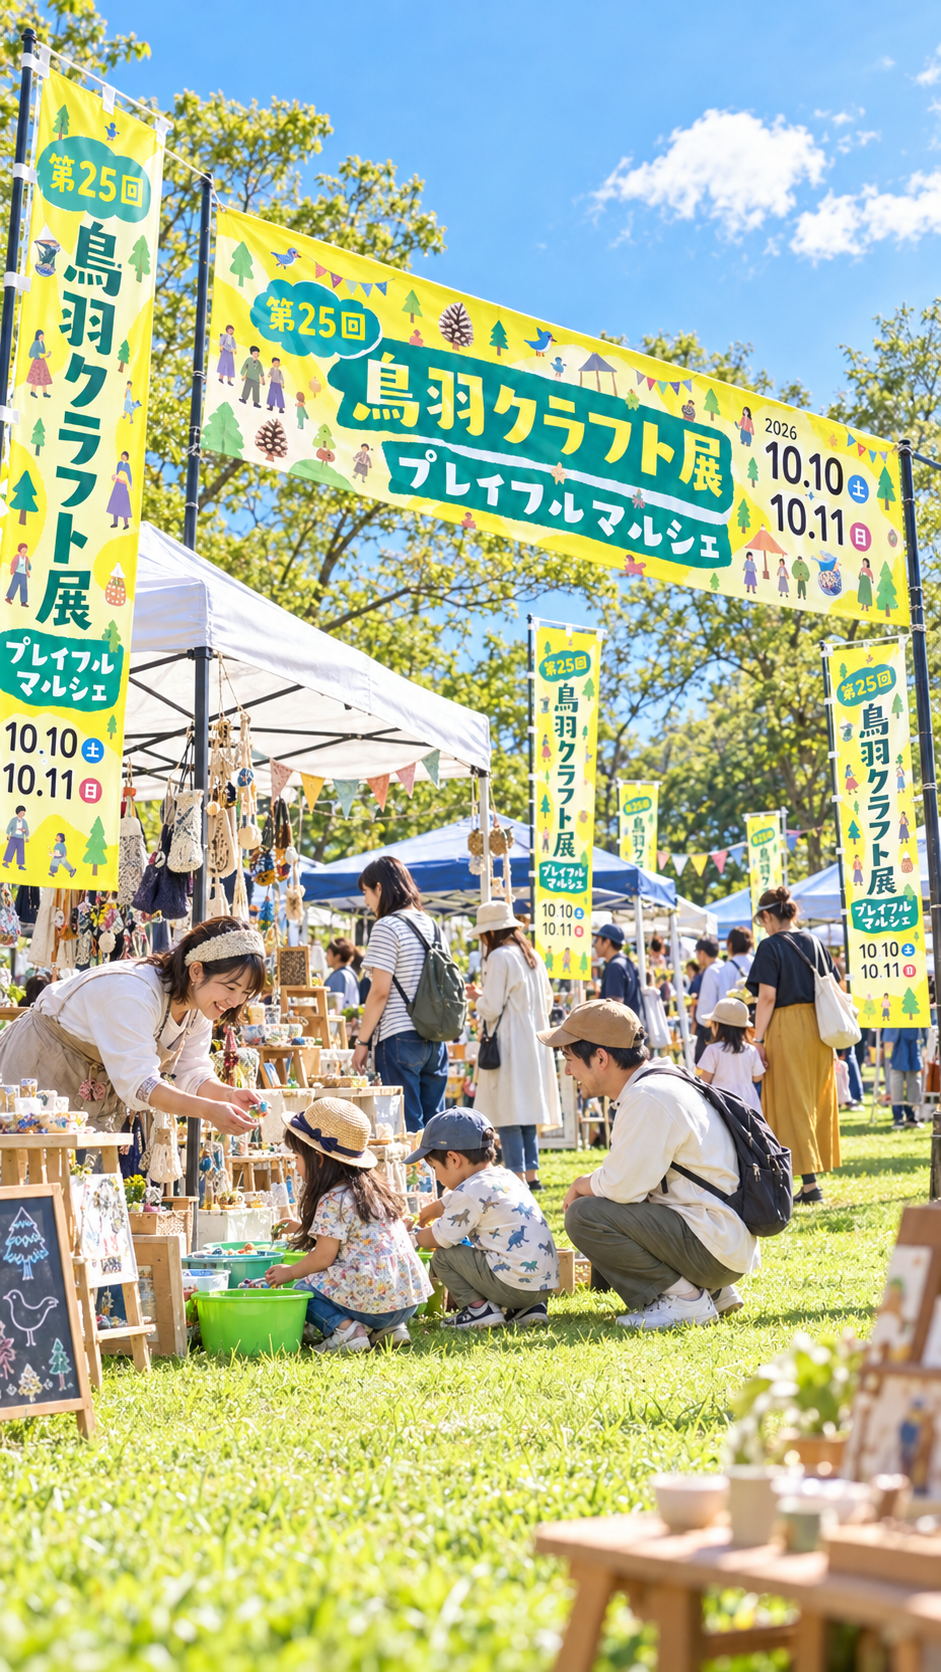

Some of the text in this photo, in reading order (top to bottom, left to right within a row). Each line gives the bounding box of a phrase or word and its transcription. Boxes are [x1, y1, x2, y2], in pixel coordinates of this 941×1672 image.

[49, 153, 144, 208] 第25回
[266, 296, 366, 341] 第25回
[35, 221, 122, 630] 鳥羽クラフト展
[352, 352, 723, 498] 鳥羽クラフト展
[765, 418, 797, 440] 2026
[765, 441, 866, 498] 10.10 土
[399, 449, 720, 559] プレイフルマルシェ
[770, 493, 866, 546] 10.11 日
[5, 635, 115, 675] プレイフル
[16, 671, 107, 702] マルシェ
[841, 669, 892, 702] 第25回
[5, 722, 100, 759] 10.10 土
[3, 763, 97, 800] 10.11 日
[552, 682, 579, 858] 鳥羽クラフト展
[859, 702, 897, 896] 鳥羽クラフト展
[542, 903, 572, 918] 10.10
[543, 922, 571, 936] 10.11
[859, 942, 899, 958] 10.10
[861, 962, 899, 979] 10.11
